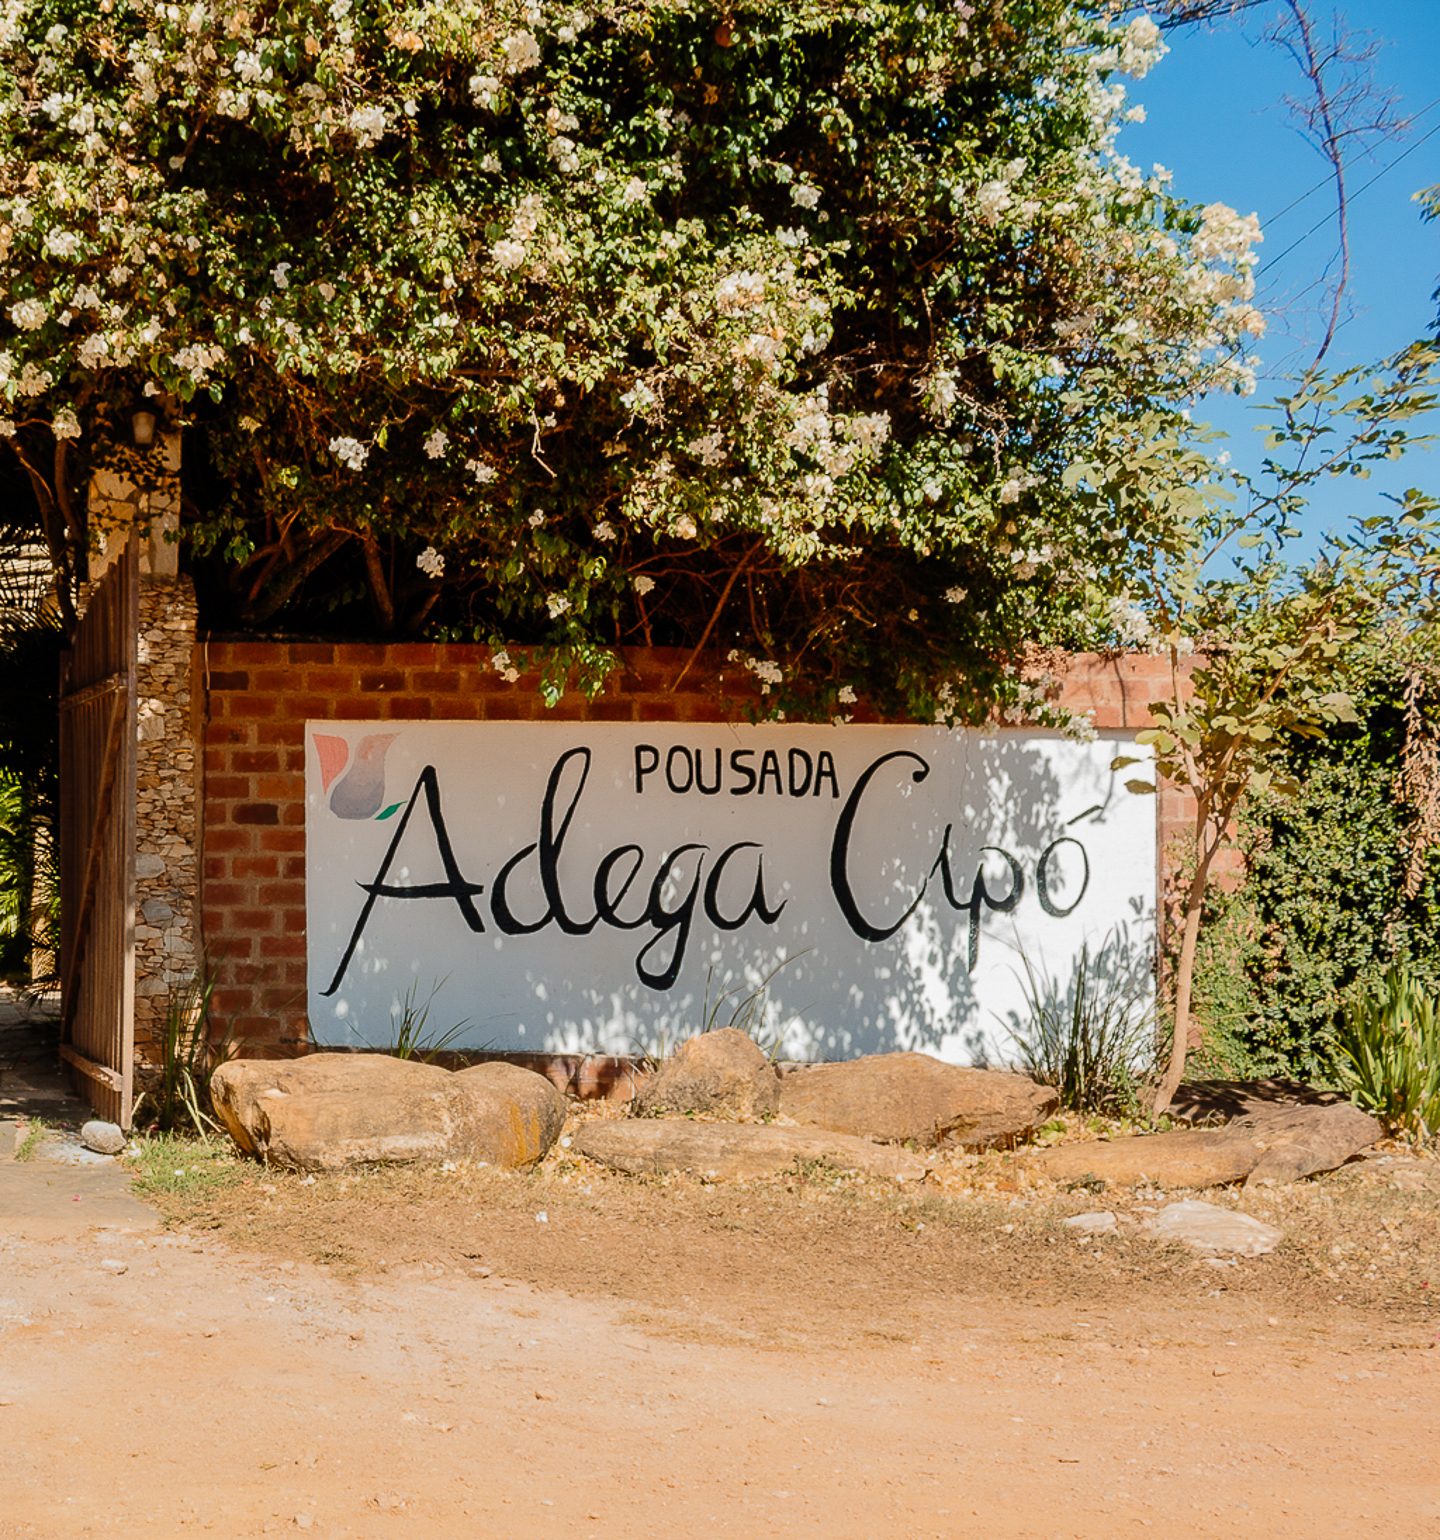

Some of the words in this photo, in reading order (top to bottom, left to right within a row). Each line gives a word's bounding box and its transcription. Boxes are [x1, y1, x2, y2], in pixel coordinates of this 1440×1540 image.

[635, 744, 840, 799] POUSADA
[317, 746, 788, 997] Adega
[830, 750, 1105, 975] Cipó
